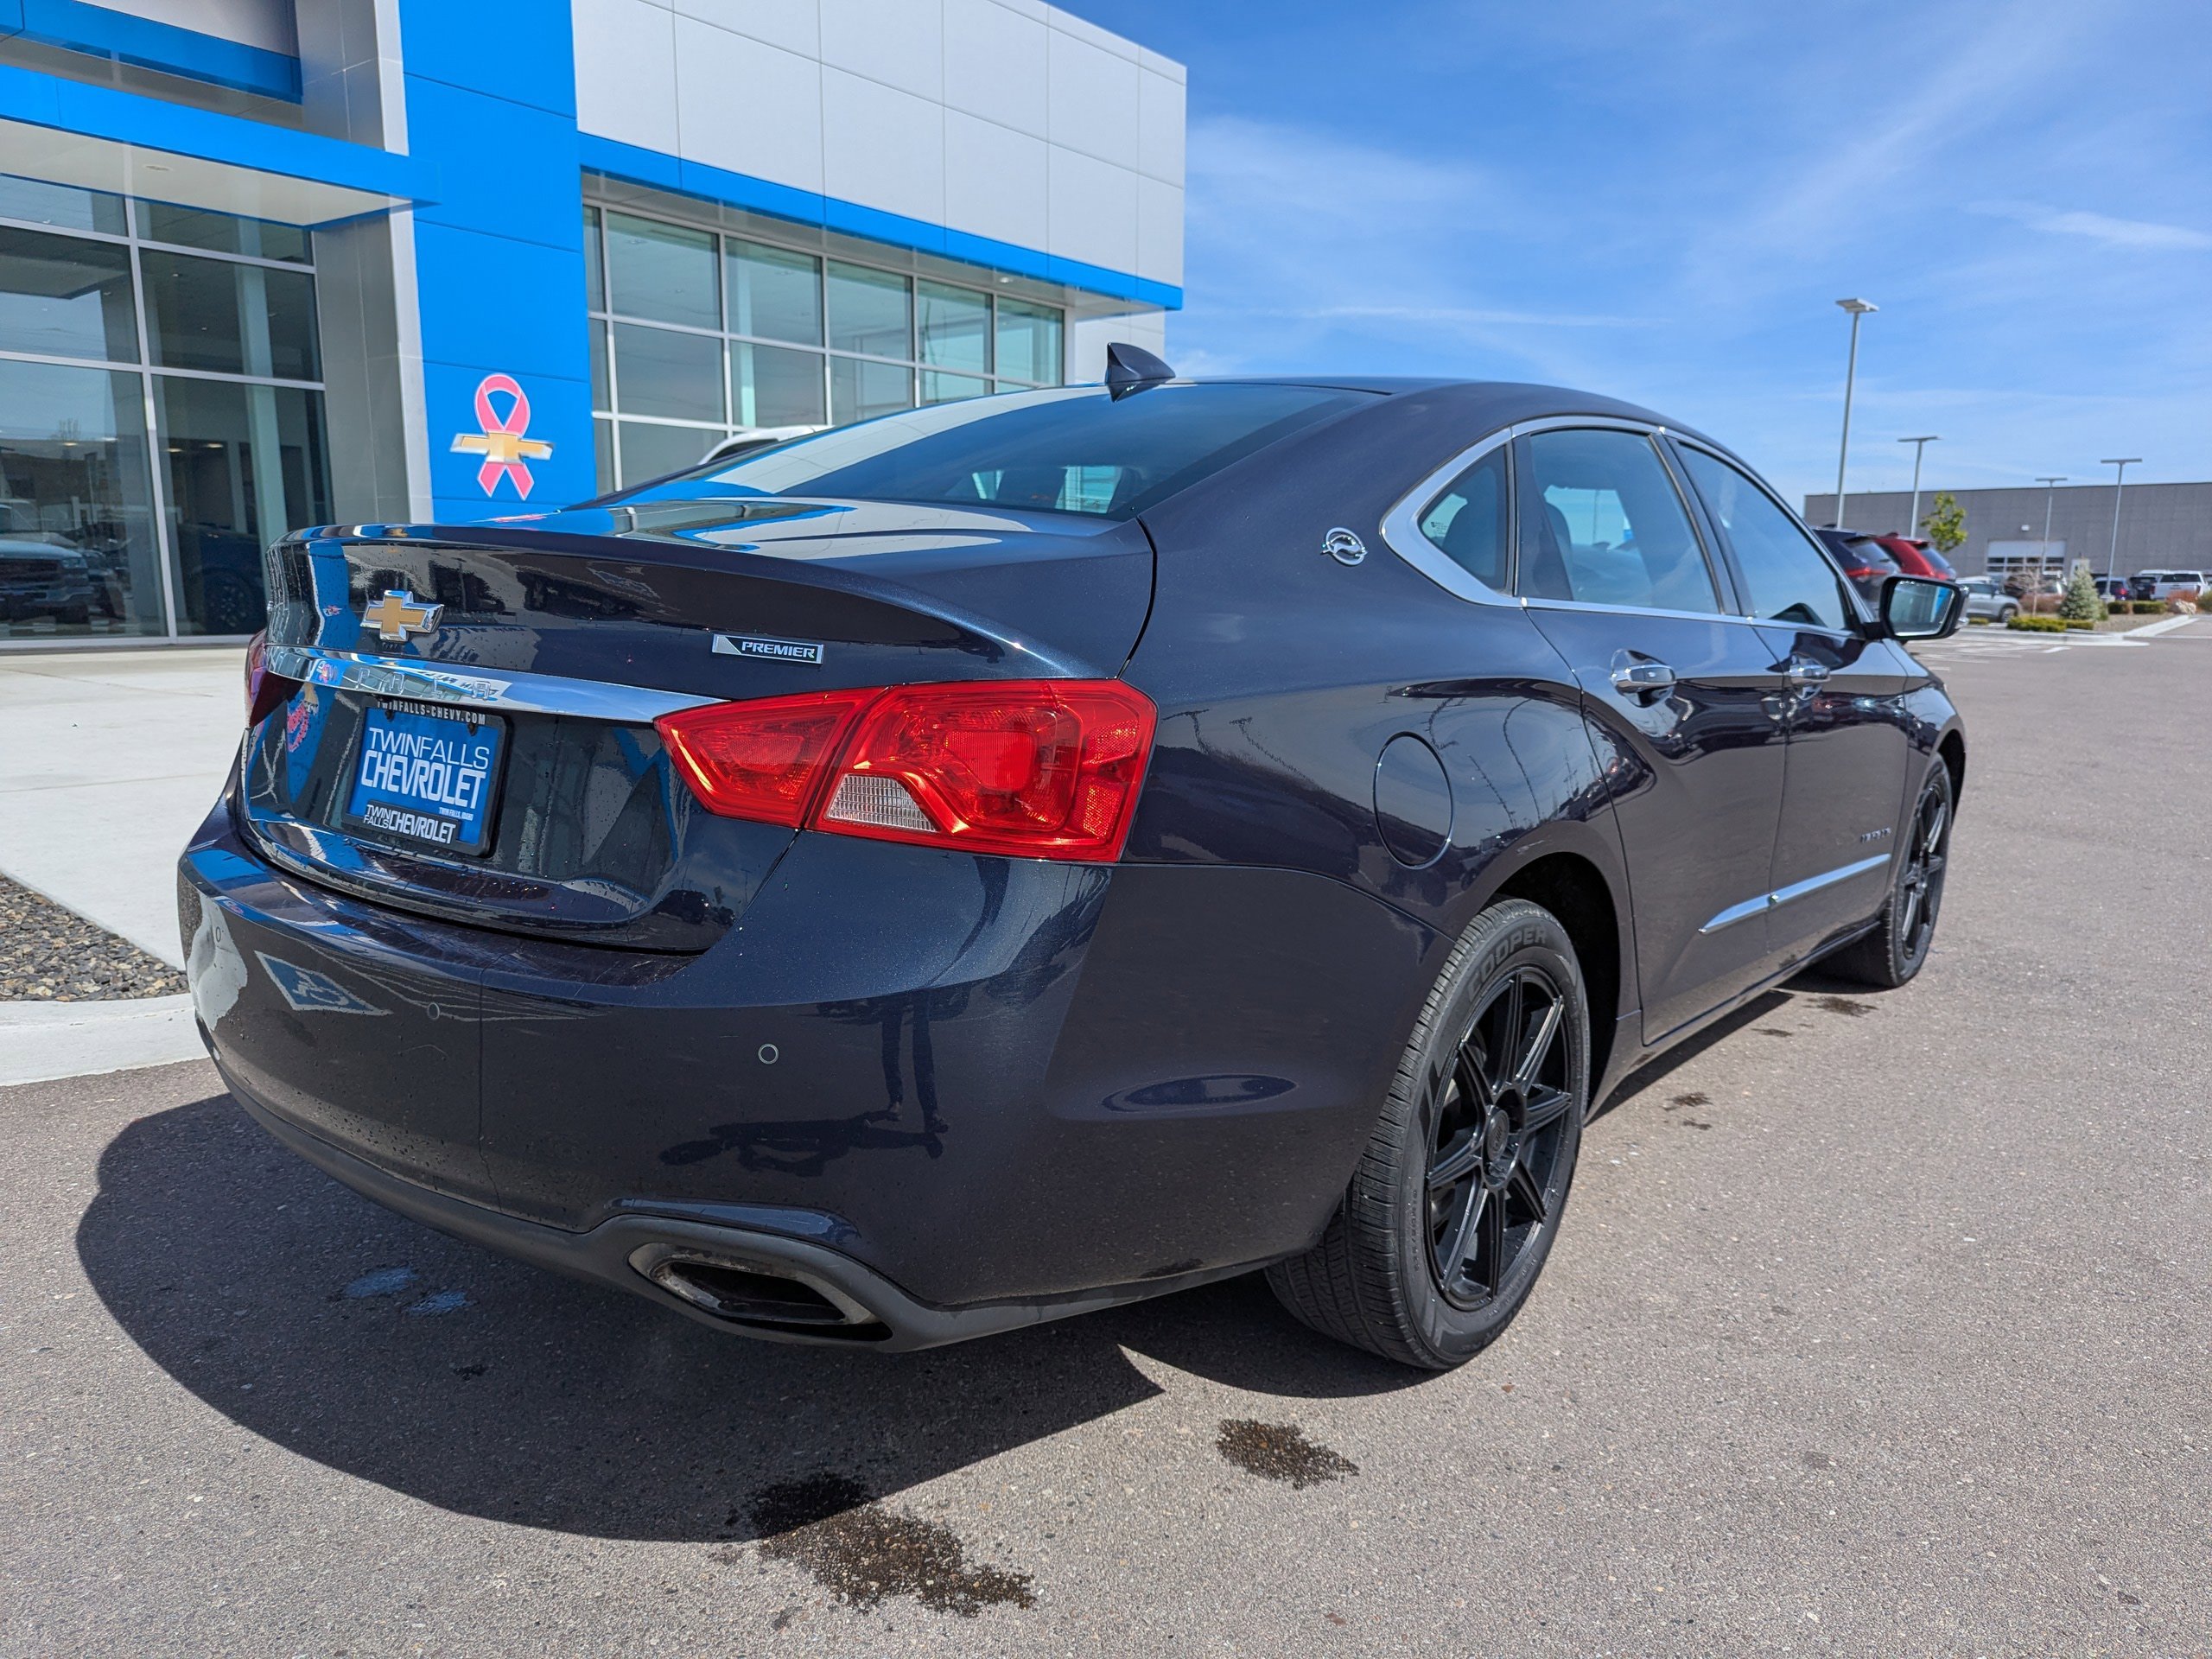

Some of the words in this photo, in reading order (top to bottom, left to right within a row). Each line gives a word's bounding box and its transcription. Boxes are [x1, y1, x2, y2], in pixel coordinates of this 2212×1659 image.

[741, 640, 815, 658] PREMIER
[360, 749, 486, 809] CHEVROLET
[363, 814, 390, 830] FALLS
[366, 804, 391, 820] TWIN
[388, 810, 456, 844] CHEVROLET
[1467, 925, 1548, 1003] COOPER
